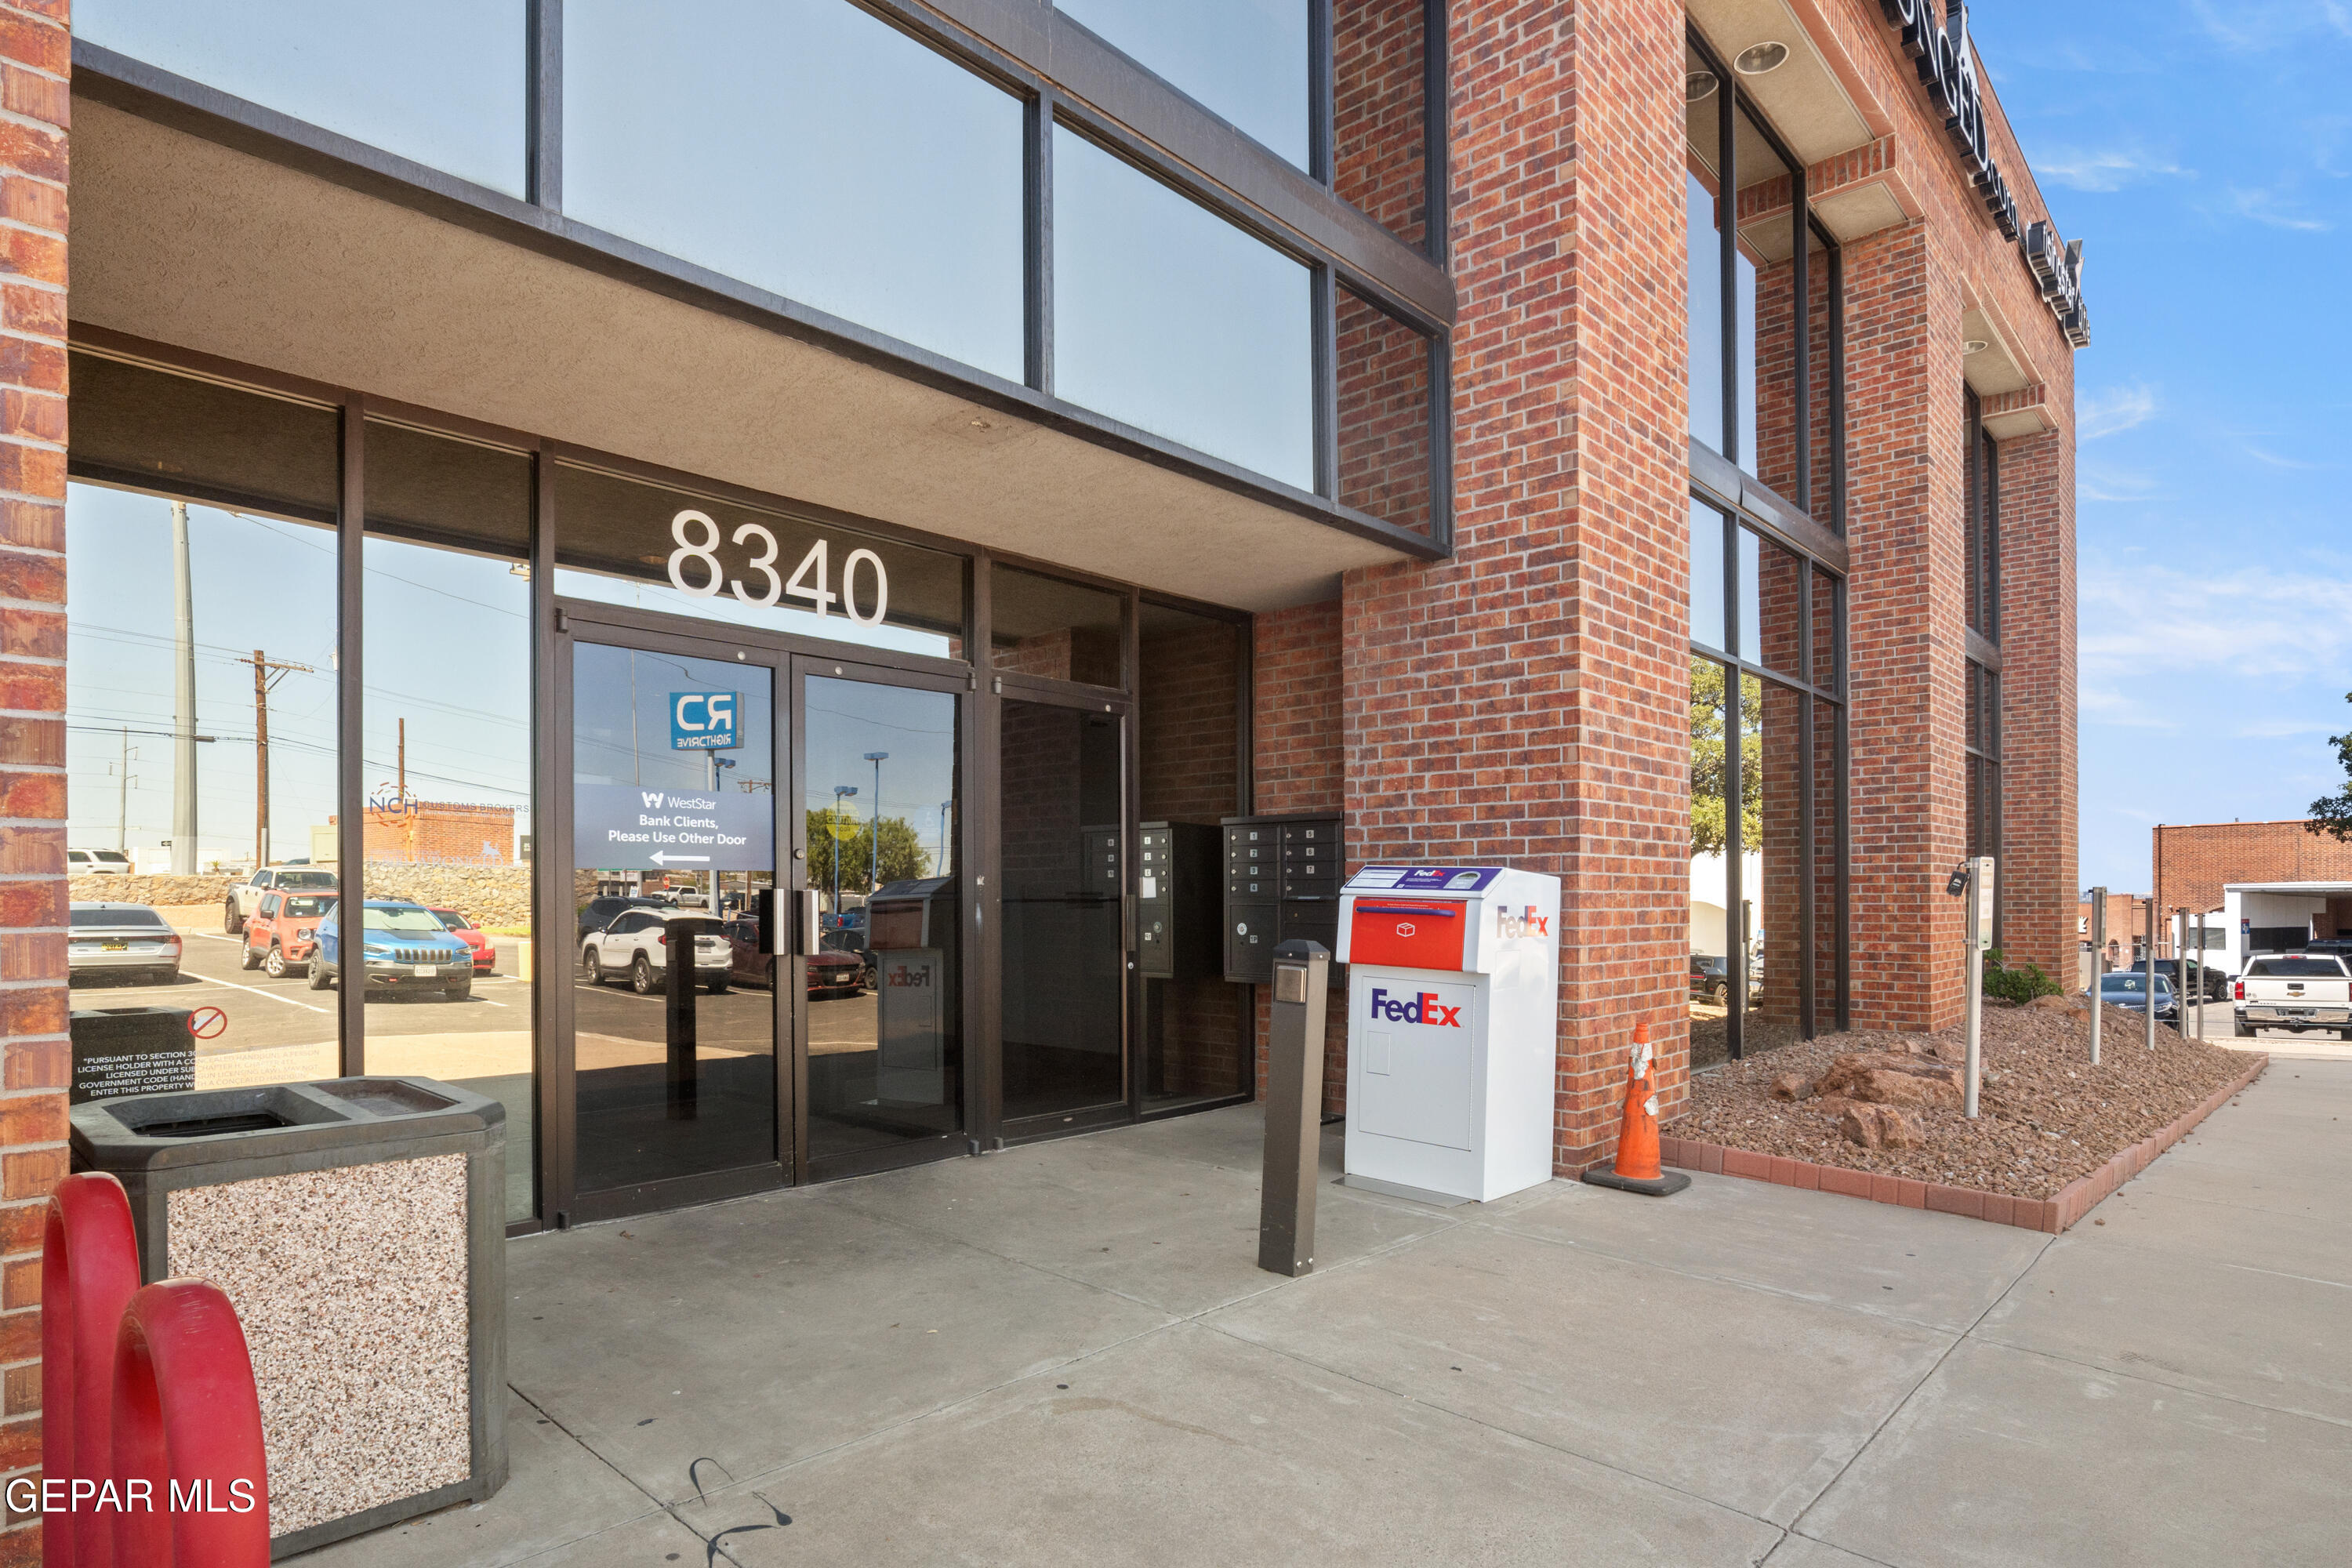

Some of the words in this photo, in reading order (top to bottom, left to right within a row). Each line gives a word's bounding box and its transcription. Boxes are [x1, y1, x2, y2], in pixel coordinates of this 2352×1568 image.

[668, 510, 887, 628] 8340
[369, 796, 418, 815] NCH
[423, 800, 477, 811] CUSTOMS
[480, 803, 530, 813] BROKERS
[667, 797, 717, 810] WestStar
[639, 814, 670, 826] Bank
[673, 815, 719, 829] Clients,
[608, 830, 649, 842] Please
[652, 831, 676, 843] Use
[679, 833, 714, 844] Other
[717, 834, 746, 845] Door
[1497, 906, 1548, 938] FedEx
[1371, 988, 1462, 1028] FedEx
[150, 1051, 186, 1060] SECTION
[78, 1064, 114, 1073] LICENSE
[116, 1062, 151, 1070] HOLDER
[106, 1070, 148, 1079] LICENSED
[150, 1067, 179, 1076] UNDER
[79, 1078, 142, 1088] GOVERNMENT
[141, 1082, 184, 1092] PROPERTY
